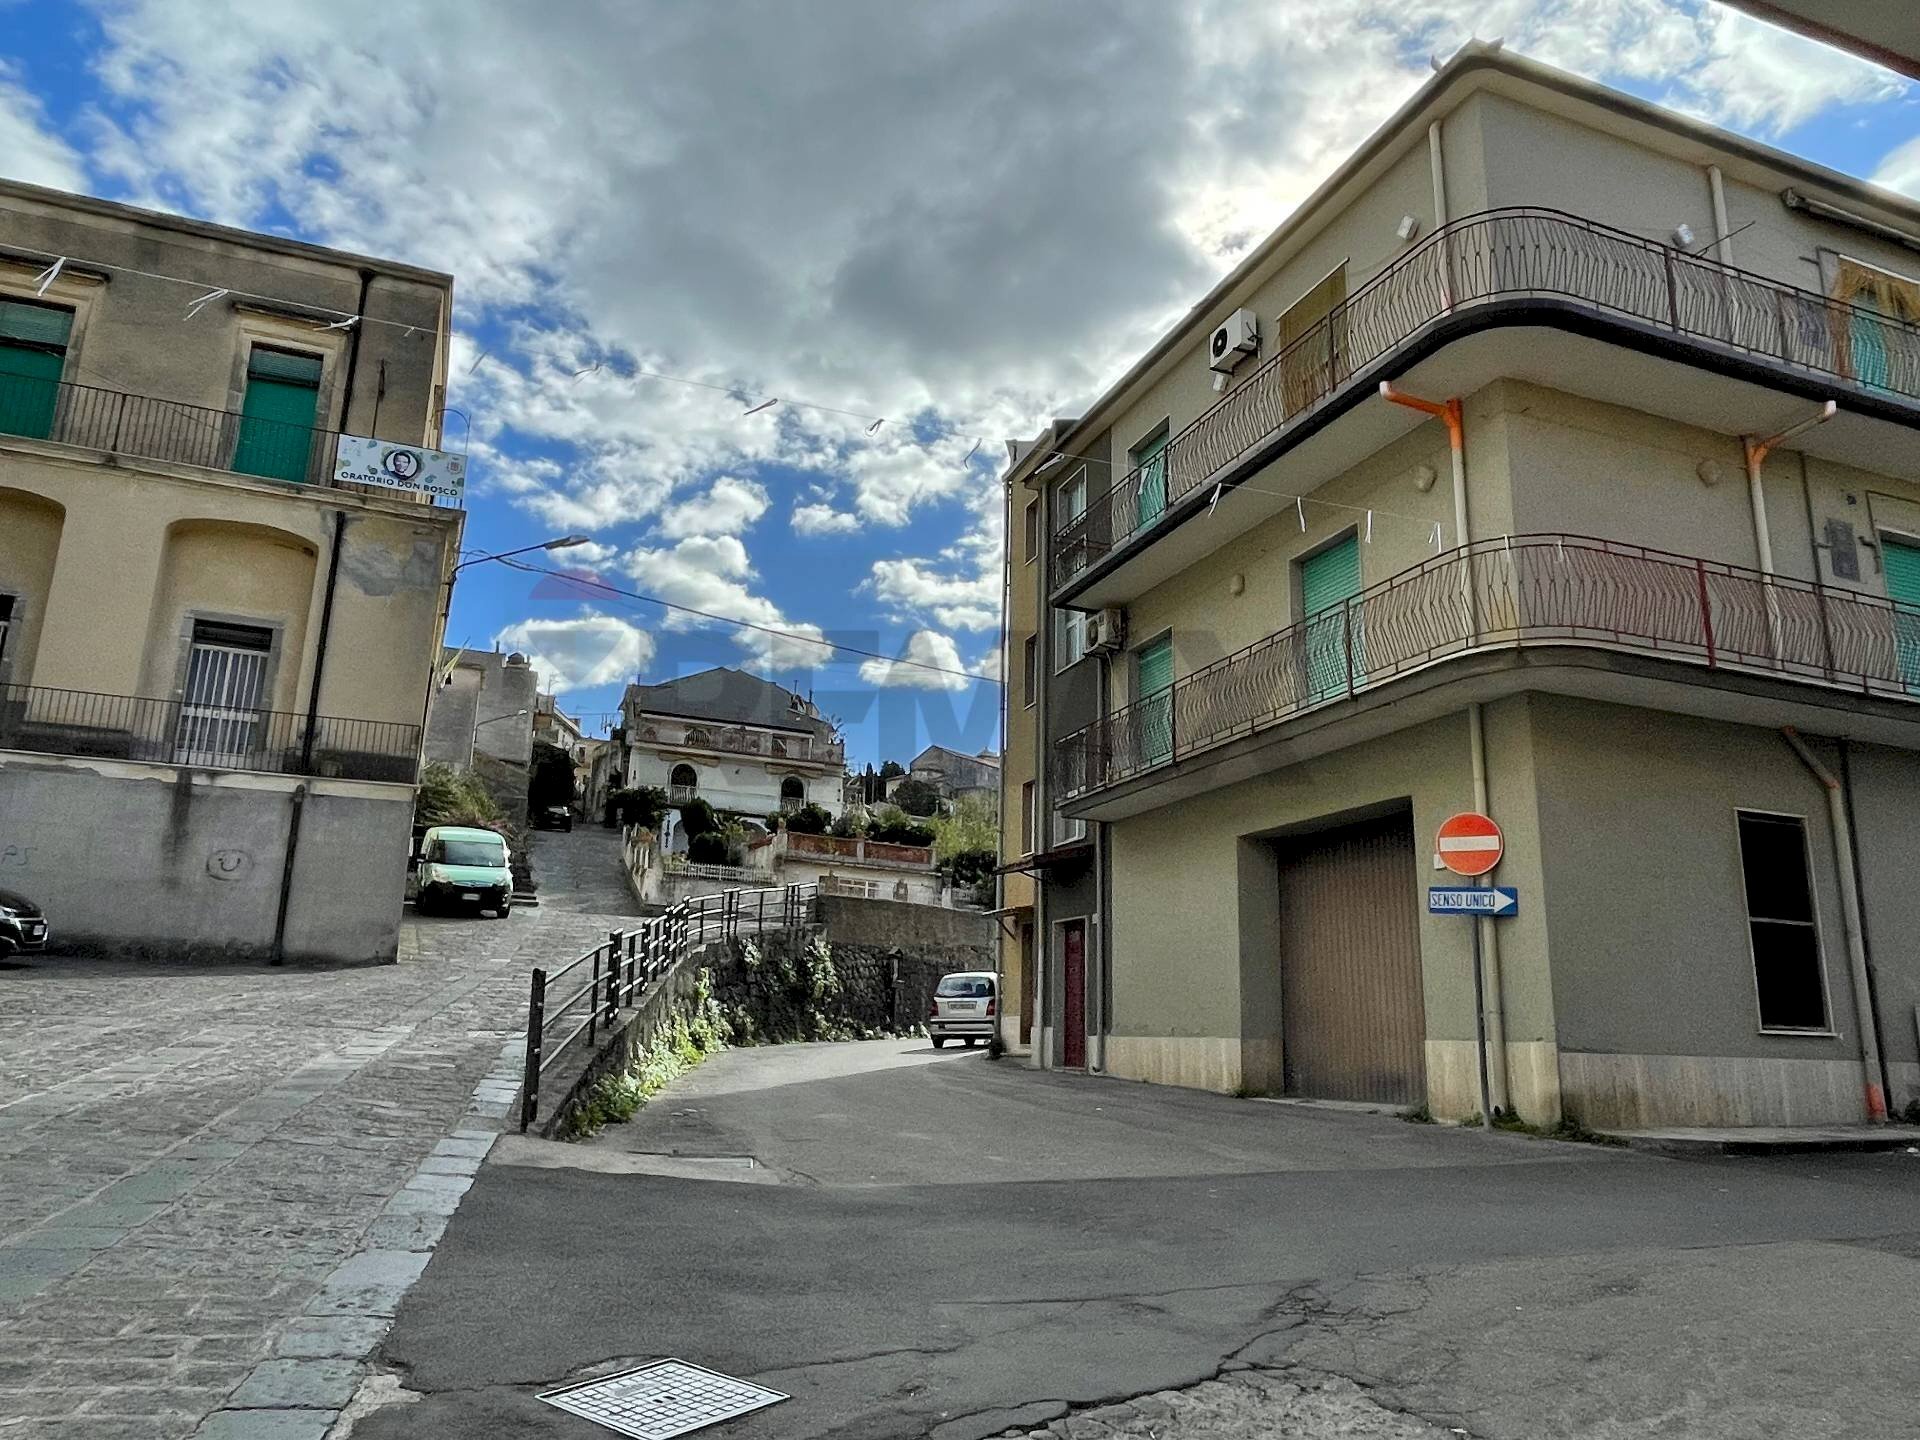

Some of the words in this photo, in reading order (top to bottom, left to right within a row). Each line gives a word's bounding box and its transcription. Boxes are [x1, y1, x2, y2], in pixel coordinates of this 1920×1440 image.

[341, 471, 394, 486] ORATORIO
[397, 480, 420, 490] DON
[423, 486, 458, 496] BOSCO
[1431, 893, 1462, 907] SENSO
[1465, 894, 1495, 907] UNICO
